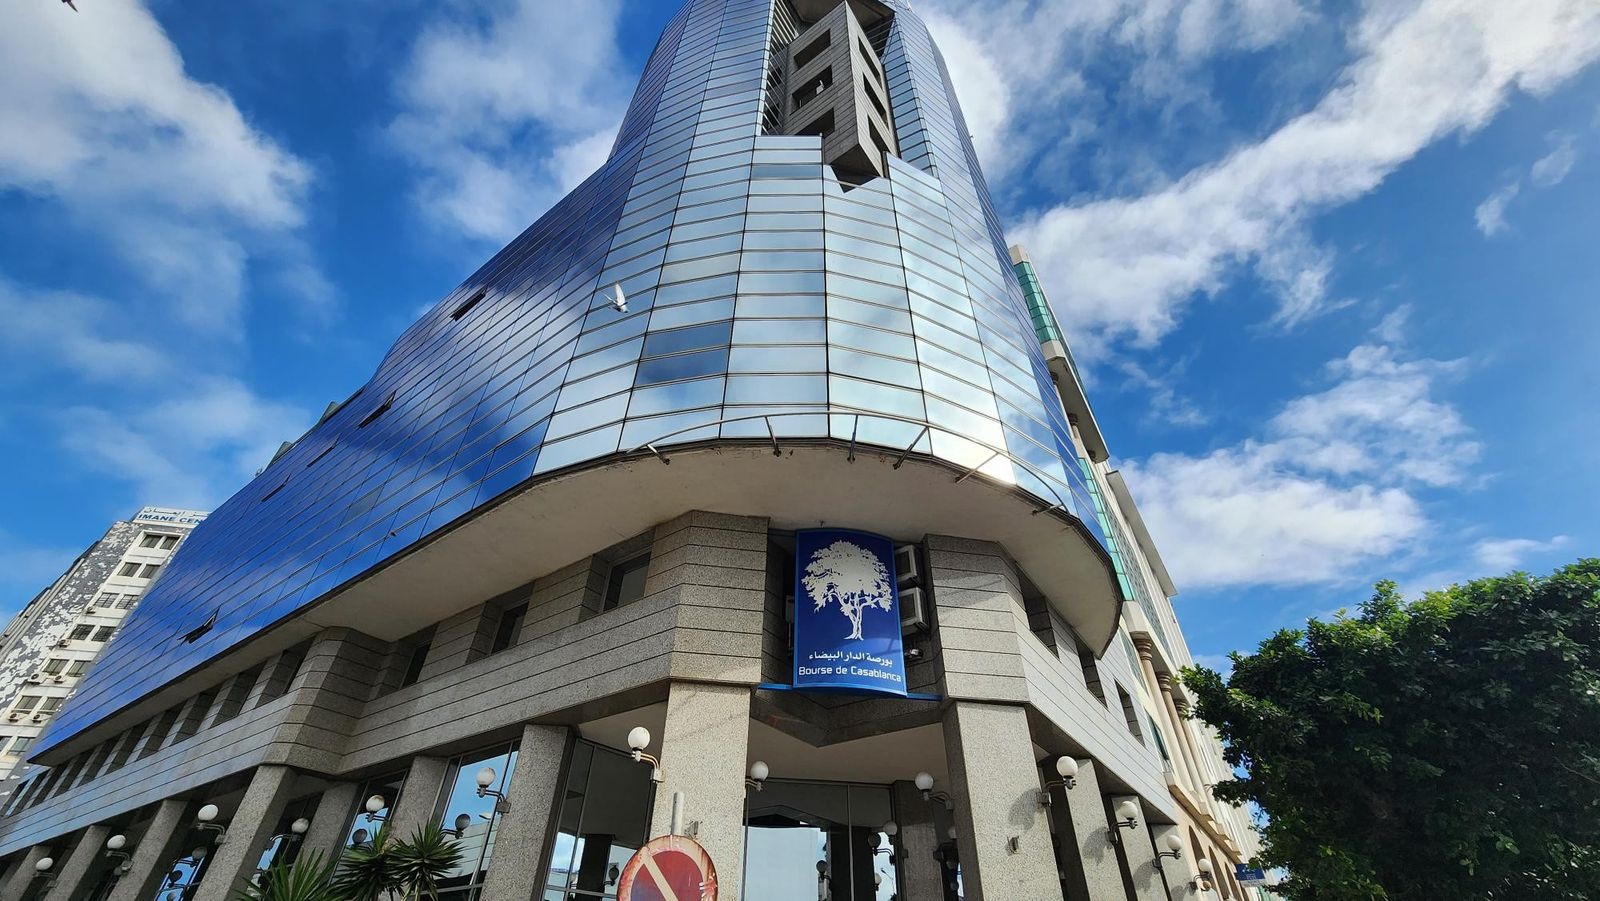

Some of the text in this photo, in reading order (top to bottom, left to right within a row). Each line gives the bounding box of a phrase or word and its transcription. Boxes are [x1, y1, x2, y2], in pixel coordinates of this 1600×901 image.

[138, 514, 176, 522] IMANE
[809, 651, 893, 667] بورصة الدار البيضاء
[799, 666, 901, 682] Bourse de Casablanca
